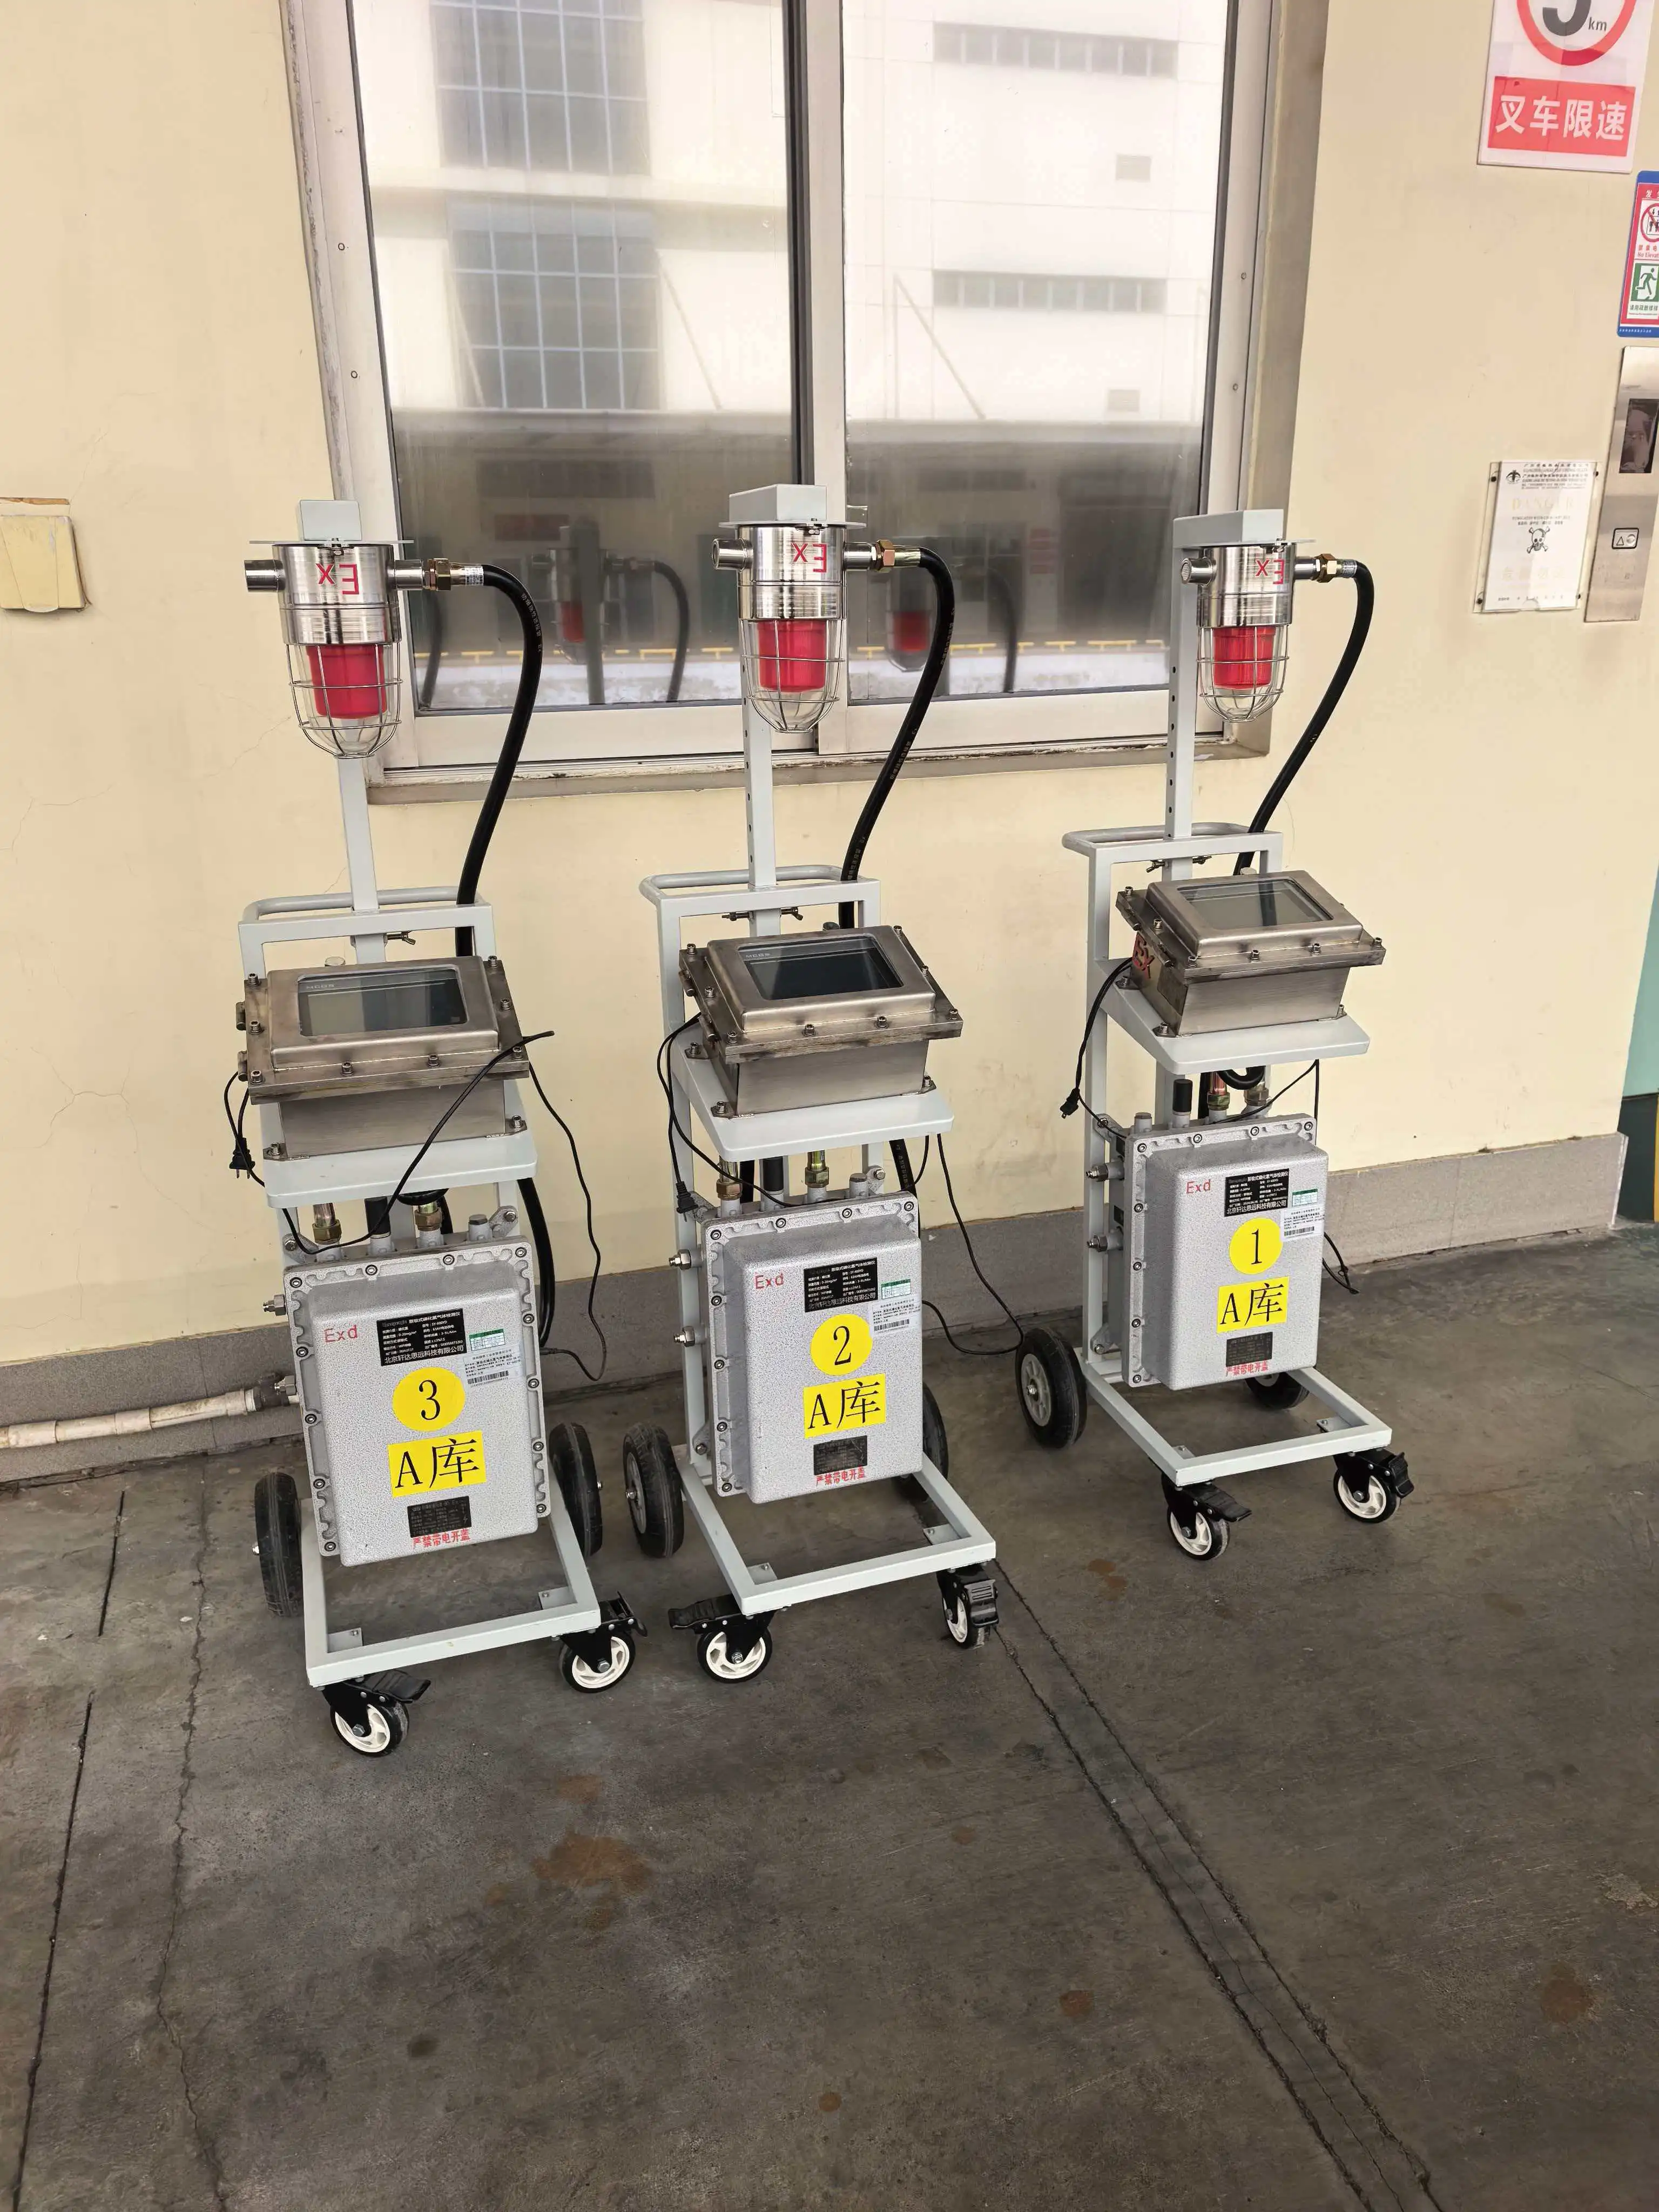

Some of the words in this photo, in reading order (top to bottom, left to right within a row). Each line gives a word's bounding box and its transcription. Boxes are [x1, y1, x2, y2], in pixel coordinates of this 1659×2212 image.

[1588, 17, 1607, 31] km
[1495, 95, 1627, 140] 叉车限速
[1186, 1179, 1211, 1194] Exd
[1251, 1229, 1262, 1265] 1
[754, 1273, 785, 1290] Exd
[1219, 1282, 1285, 1326] A库
[323, 1326, 358, 1343] Exd
[833, 1325, 851, 1365] 2
[385, 1345, 464, 1364] 北京轩达思远科技有限公司
[419, 1380, 441, 1420] 3
[808, 1381, 881, 1429] A库
[395, 1438, 480, 1489] A库
[412, 1528, 471, 1549] 严禁带电开盖
